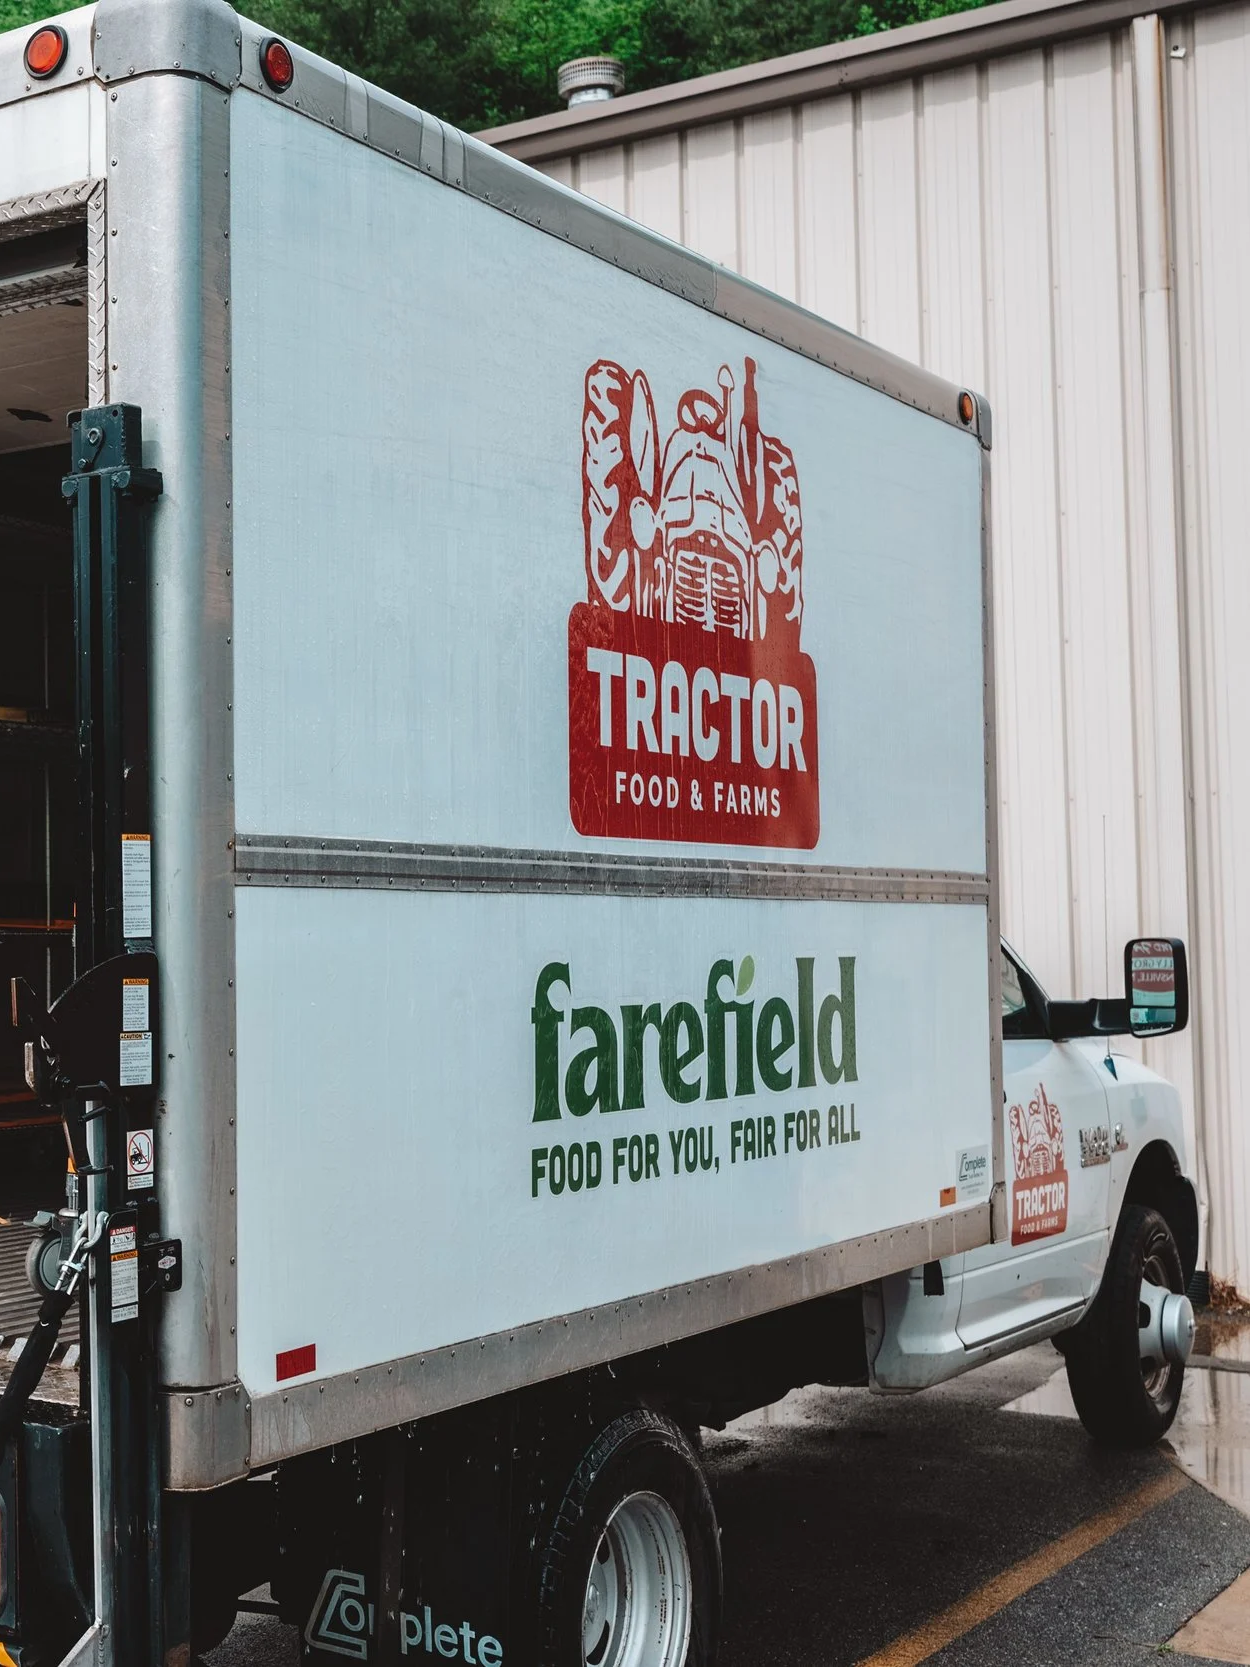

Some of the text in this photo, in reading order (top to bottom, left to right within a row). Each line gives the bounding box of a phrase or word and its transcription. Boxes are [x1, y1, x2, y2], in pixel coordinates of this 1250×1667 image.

[586, 646, 808, 773] TRACTOR
[615, 771, 781, 818] FOOD & FARMS
[531, 955, 859, 1123] farefield
[531, 1103, 861, 1198] FOOD FOR YOU, FAIR FOR ALL
[1016, 1181, 1066, 1220] TRACTOR
[1020, 1216, 1058, 1235] FOOD & FARMS
[304, 1568, 504, 1667] Coplete
